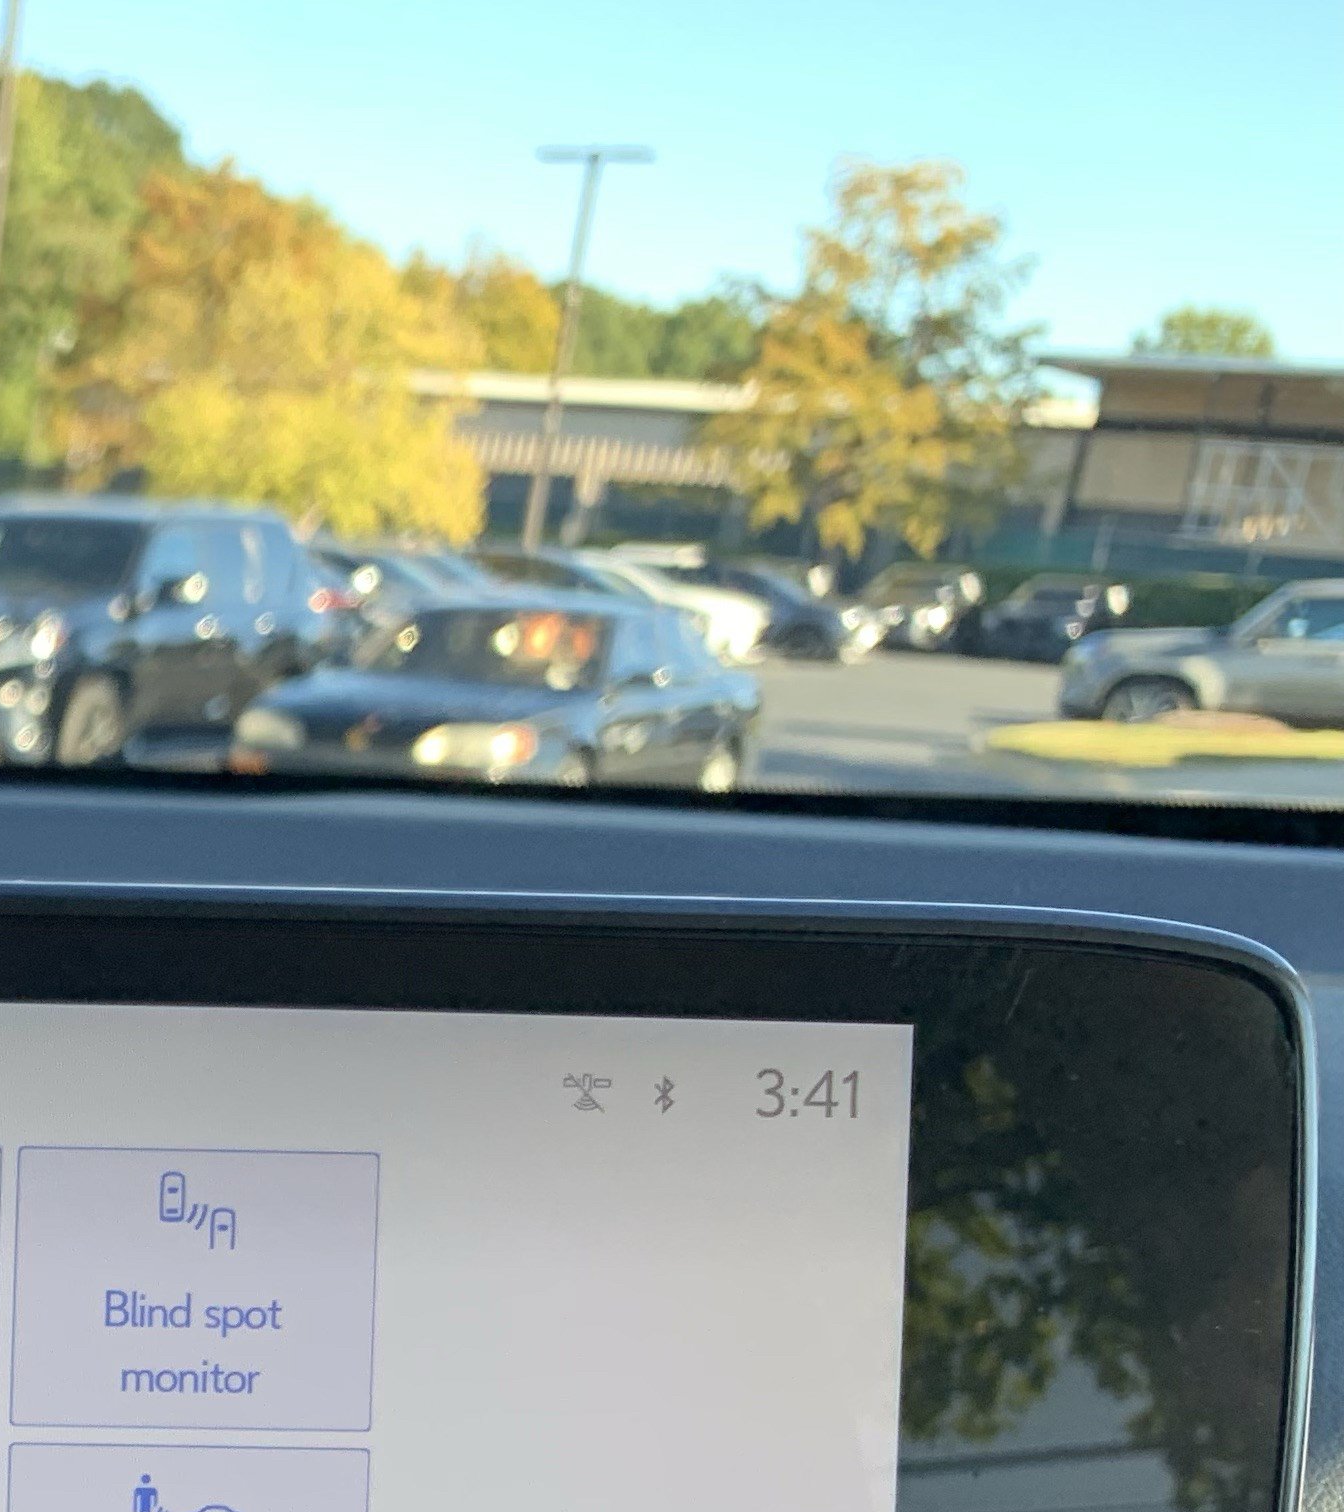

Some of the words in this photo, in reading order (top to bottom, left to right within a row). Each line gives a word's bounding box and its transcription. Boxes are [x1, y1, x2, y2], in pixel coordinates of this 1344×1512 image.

[756, 1068, 859, 1118] 3:41
[105, 1290, 191, 1328] Blind
[205, 1300, 282, 1338] spot
[122, 1360, 260, 1394] monitor
